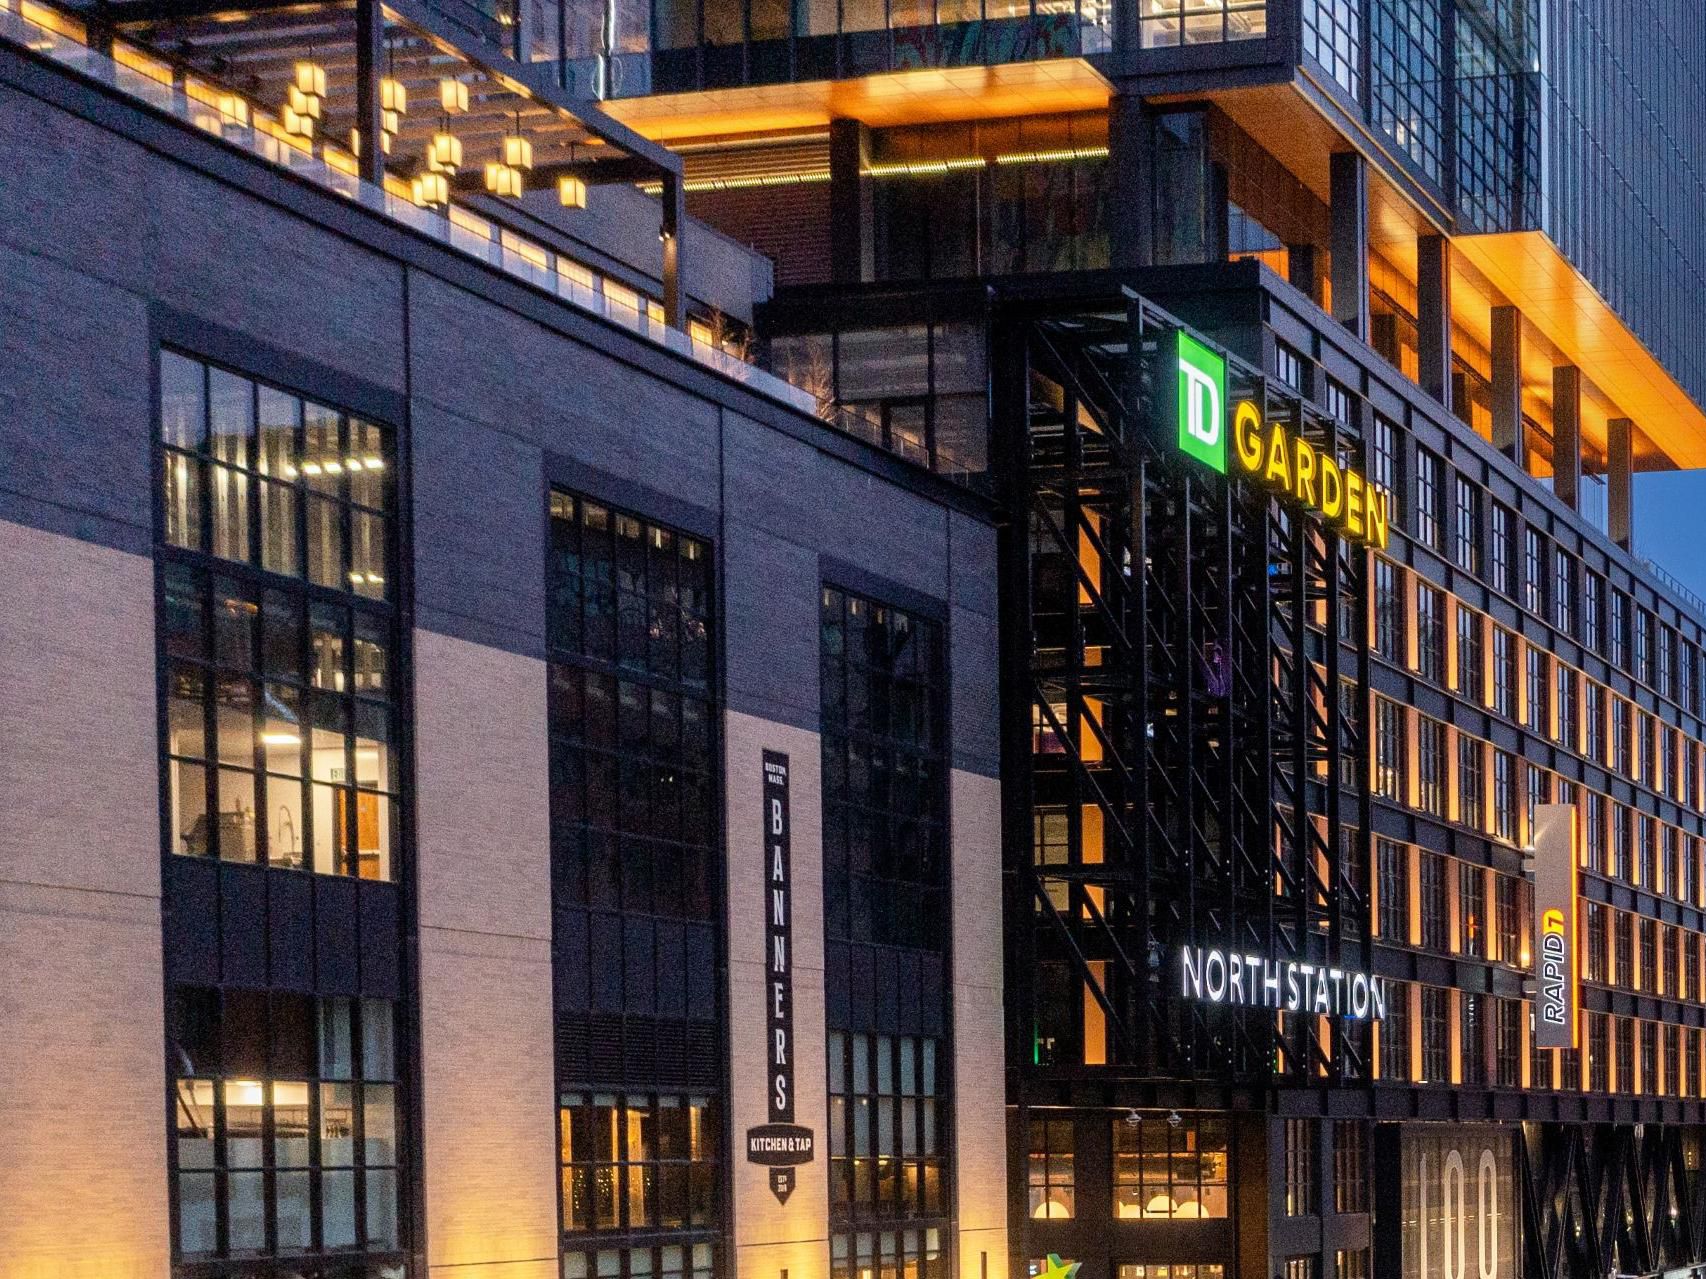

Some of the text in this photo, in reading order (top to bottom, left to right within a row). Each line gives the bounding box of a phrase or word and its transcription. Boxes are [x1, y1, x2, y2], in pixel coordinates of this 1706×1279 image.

[1179, 357, 1387, 549] TD GARDEN
[771, 798, 787, 1111] BANNERS
[1183, 945, 1386, 1019] NORTH STATION
[1543, 907, 1565, 1025] RAPID7
